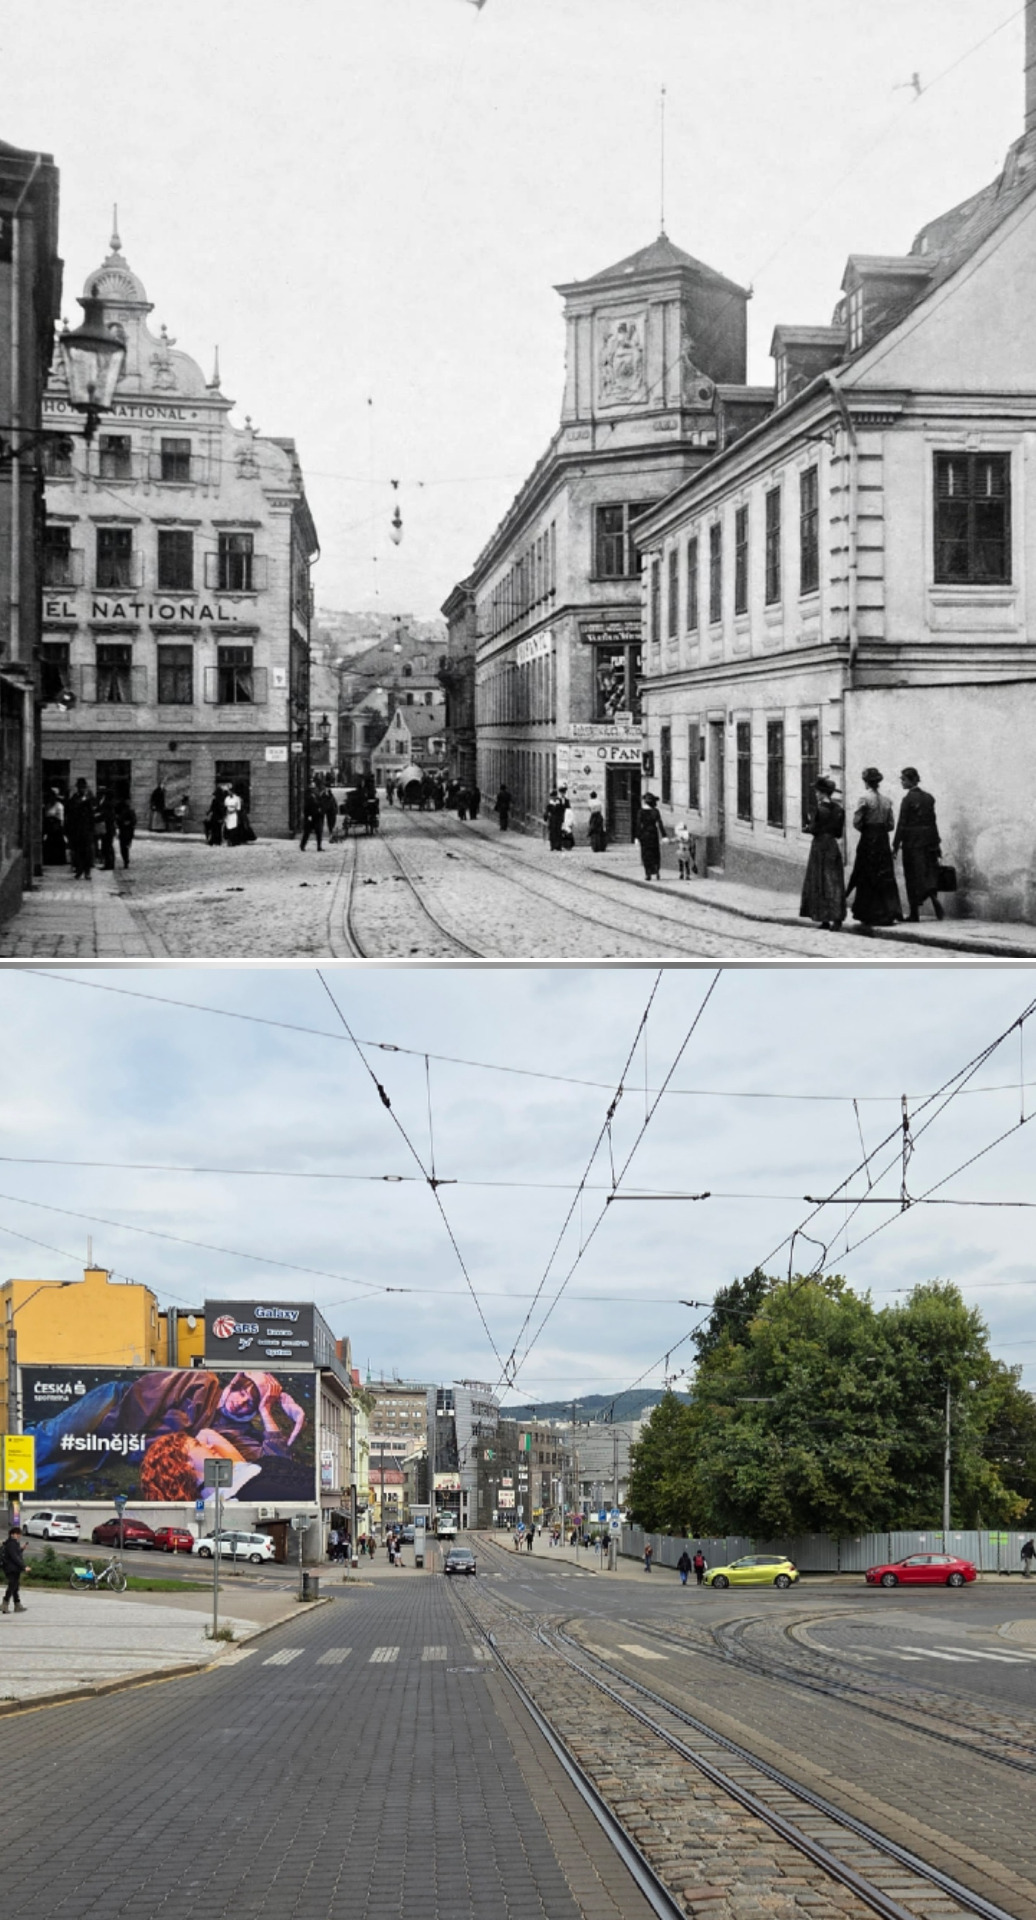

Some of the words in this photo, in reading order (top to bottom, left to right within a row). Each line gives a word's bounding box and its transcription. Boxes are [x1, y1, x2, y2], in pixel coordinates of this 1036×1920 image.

[46, 601, 77, 618] EL
[92, 602, 237, 621] NATIONAL.
[254, 1306, 299, 1322] Galaxy
[233, 1322, 259, 1334] GRS
[34, 1381, 72, 1394] ČESKÁ
[60, 1433, 147, 1456] #silnější
